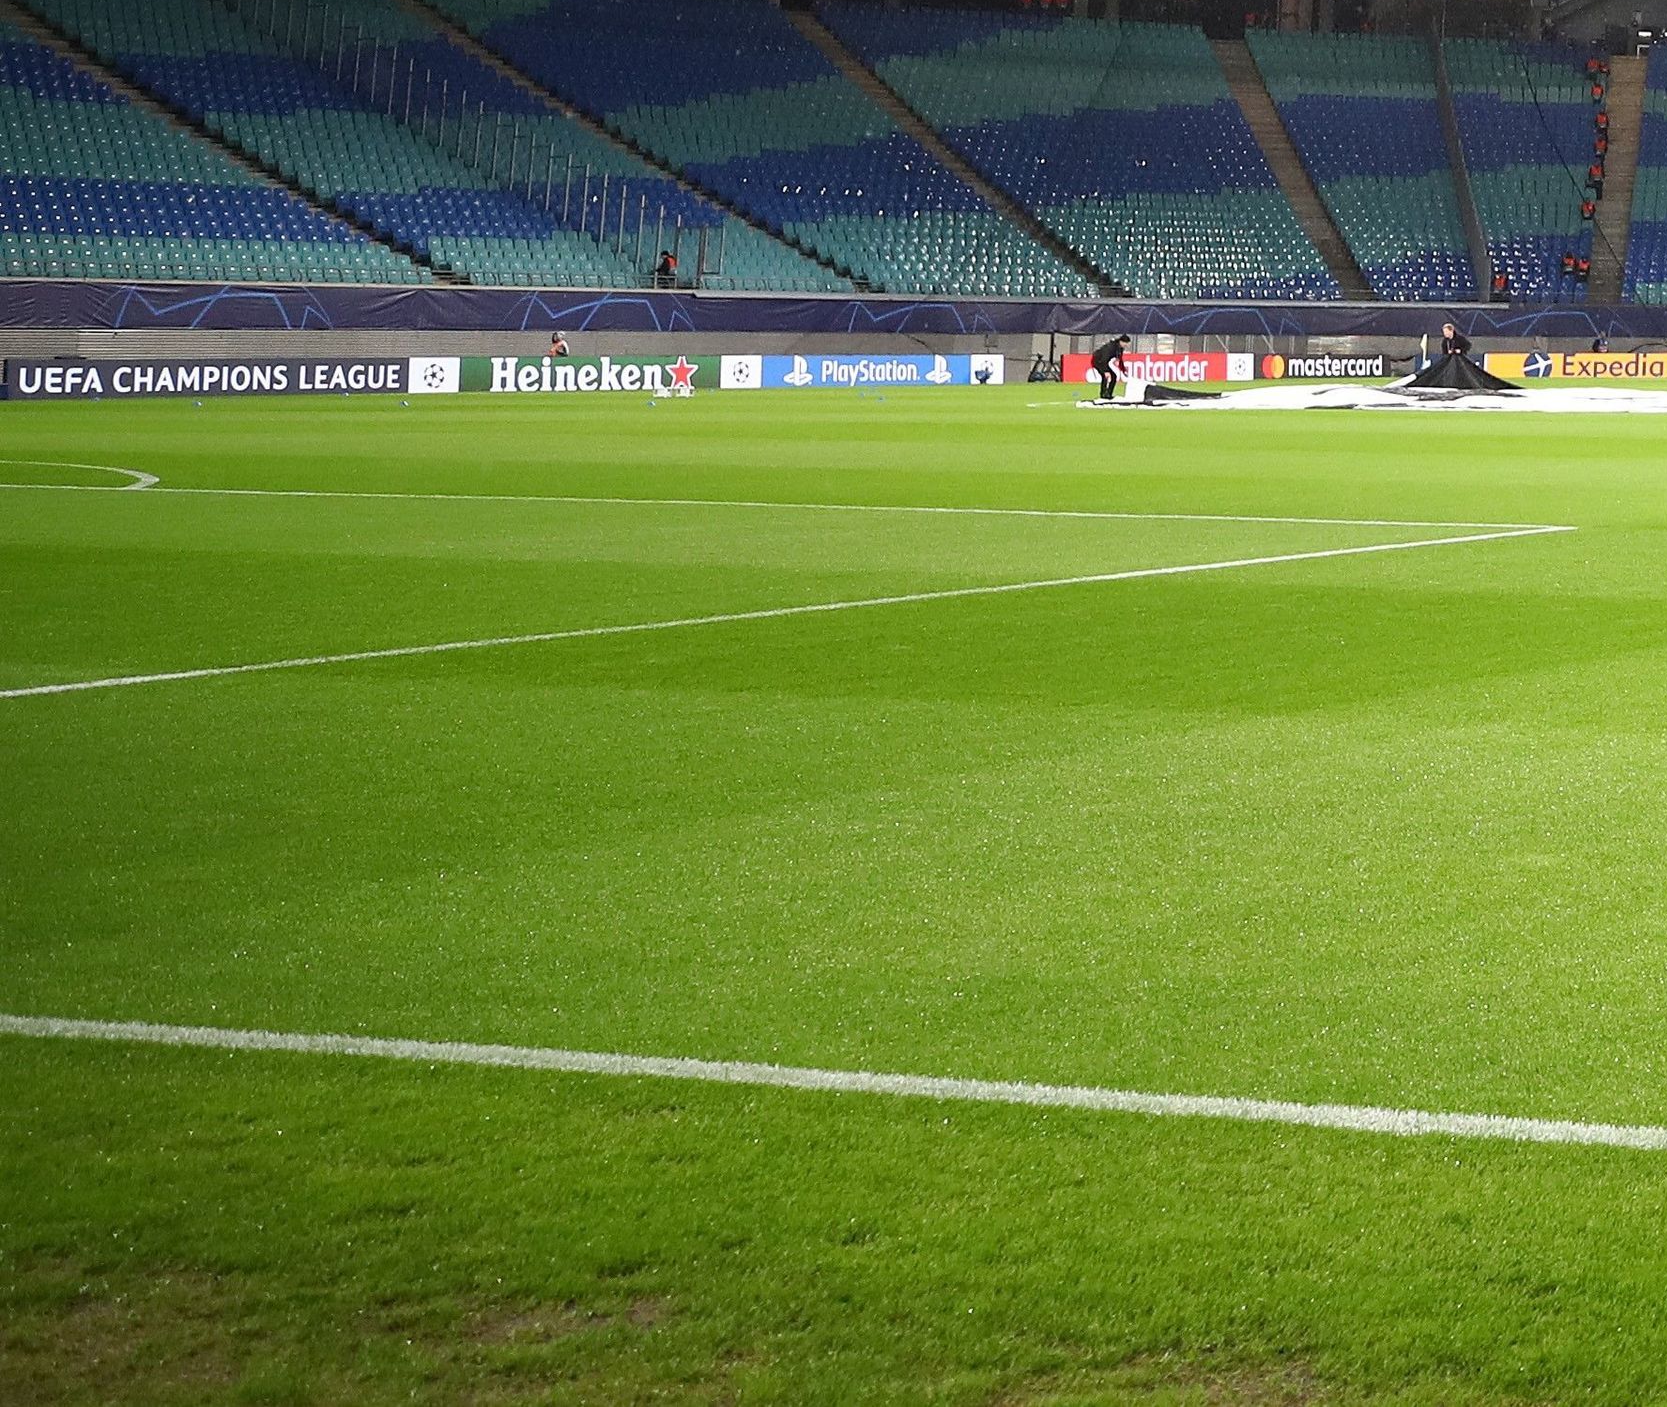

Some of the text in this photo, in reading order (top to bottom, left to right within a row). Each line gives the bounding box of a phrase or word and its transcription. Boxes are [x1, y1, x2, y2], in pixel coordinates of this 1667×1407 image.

[490, 356, 663, 392] Heineken
[1288, 353, 1383, 377] mastercard
[1562, 353, 1664, 377] Expedia
[18, 364, 400, 394] UEFA CHAMPIONS LEAGUE
